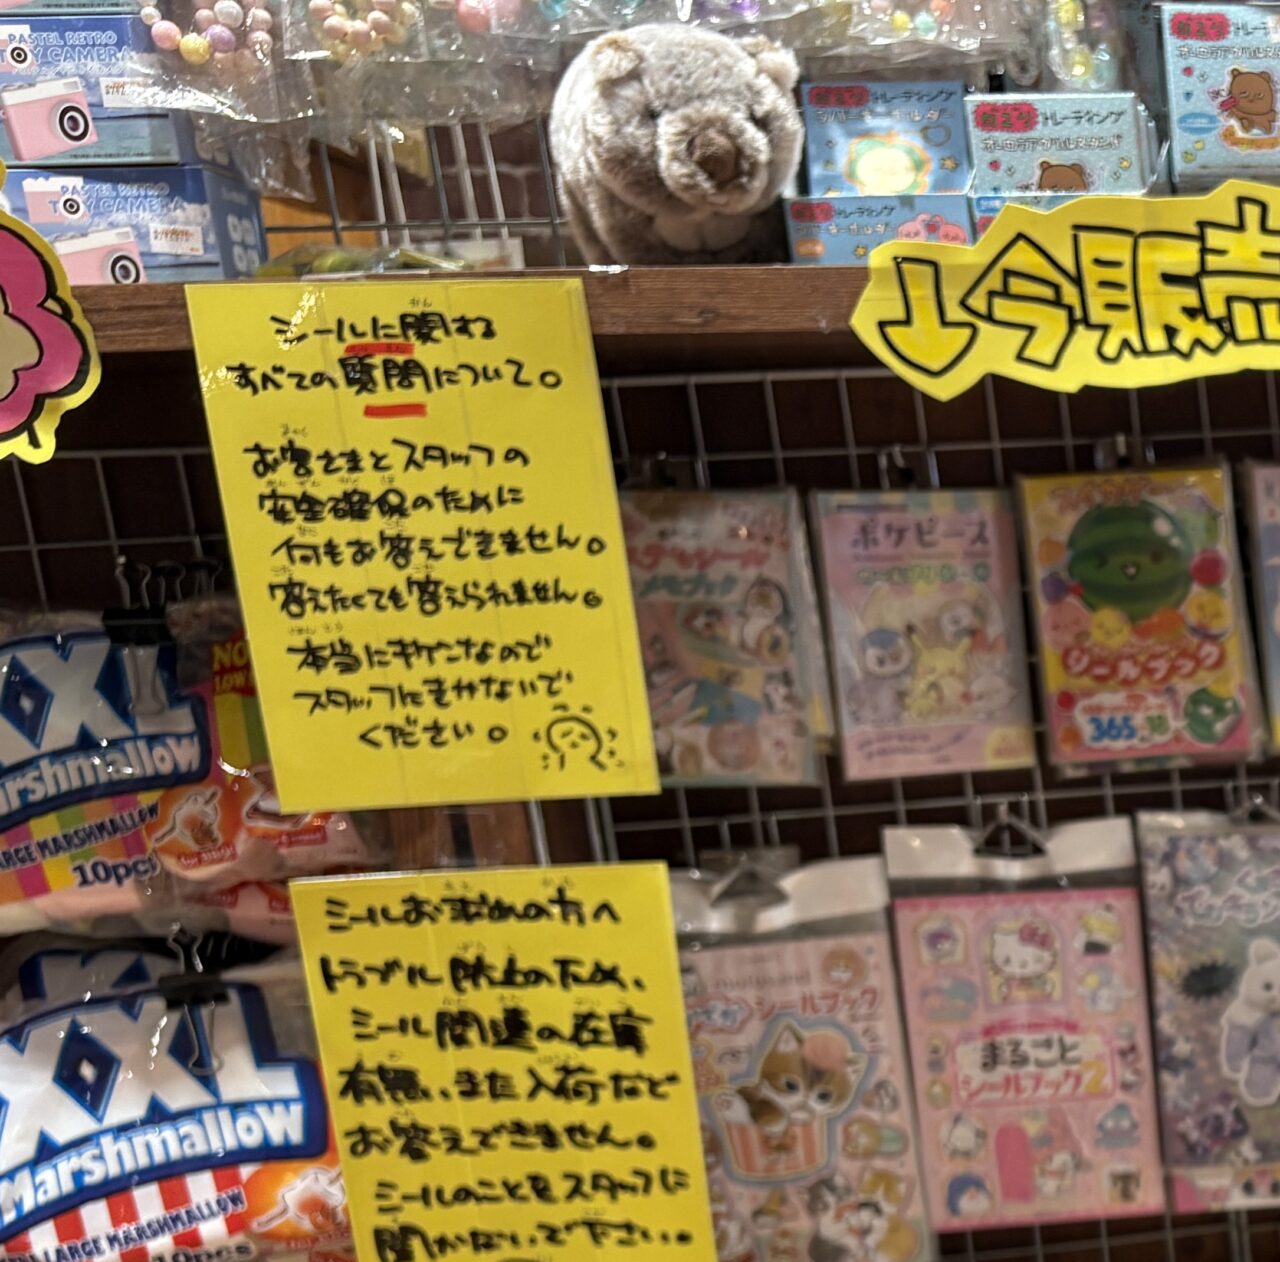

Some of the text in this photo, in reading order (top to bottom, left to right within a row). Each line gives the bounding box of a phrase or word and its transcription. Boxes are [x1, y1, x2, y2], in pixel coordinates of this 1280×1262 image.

[7, 30, 118, 46] PASTEL RETRO
[48, 45, 134, 65] CAMERA
[1039, 110, 1127, 126] トレーディング
[61, 183, 115, 199] PASTEL
[99, 196, 187, 215] CAMERA
[270, 311, 497, 346] シールに関する
[225, 355, 564, 397] すべての質問について。
[243, 437, 530, 479] お客さまとスタッフの
[257, 485, 526, 522] 安全確保のために
[270, 526, 607, 570] 何もお答えできません。
[853, 519, 991, 552] ポケピース
[267, 575, 604, 621] 答えたくても答えられません。
[286, 633, 553, 675] 本当にキケンなので
[1062, 638, 1227, 689] シールブック
[293, 669, 575, 716] スタッフにきかないで
[358, 715, 509, 749] ください。
[1088, 714, 1137, 743] 365
[38, 802, 161, 862] MARSHMALLOW
[756, 987, 878, 1021] シールブック
[978, 1033, 1083, 1070] まるごと
[343, 1117, 657, 1161] お答えできません。
[374, 1167, 692, 1214] シールのことをスタッフに
[108, 1187, 246, 1253] MARSHMALLOW
